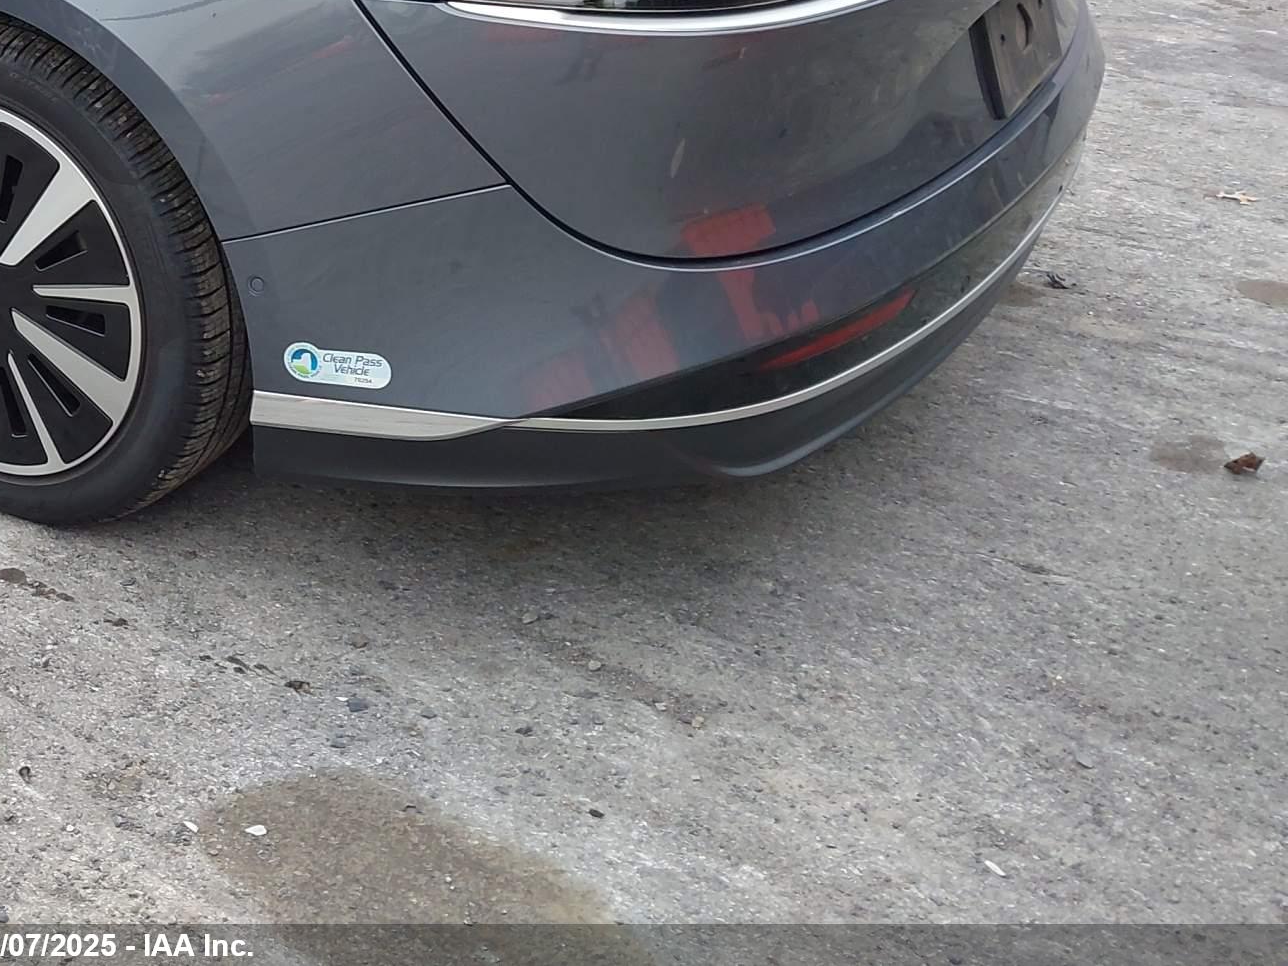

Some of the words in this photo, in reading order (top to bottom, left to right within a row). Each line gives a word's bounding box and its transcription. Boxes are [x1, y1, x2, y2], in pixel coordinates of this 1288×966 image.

[323, 353, 352, 365] Clean
[354, 355, 383, 367] Pass
[333, 363, 370, 377] Vehicle
